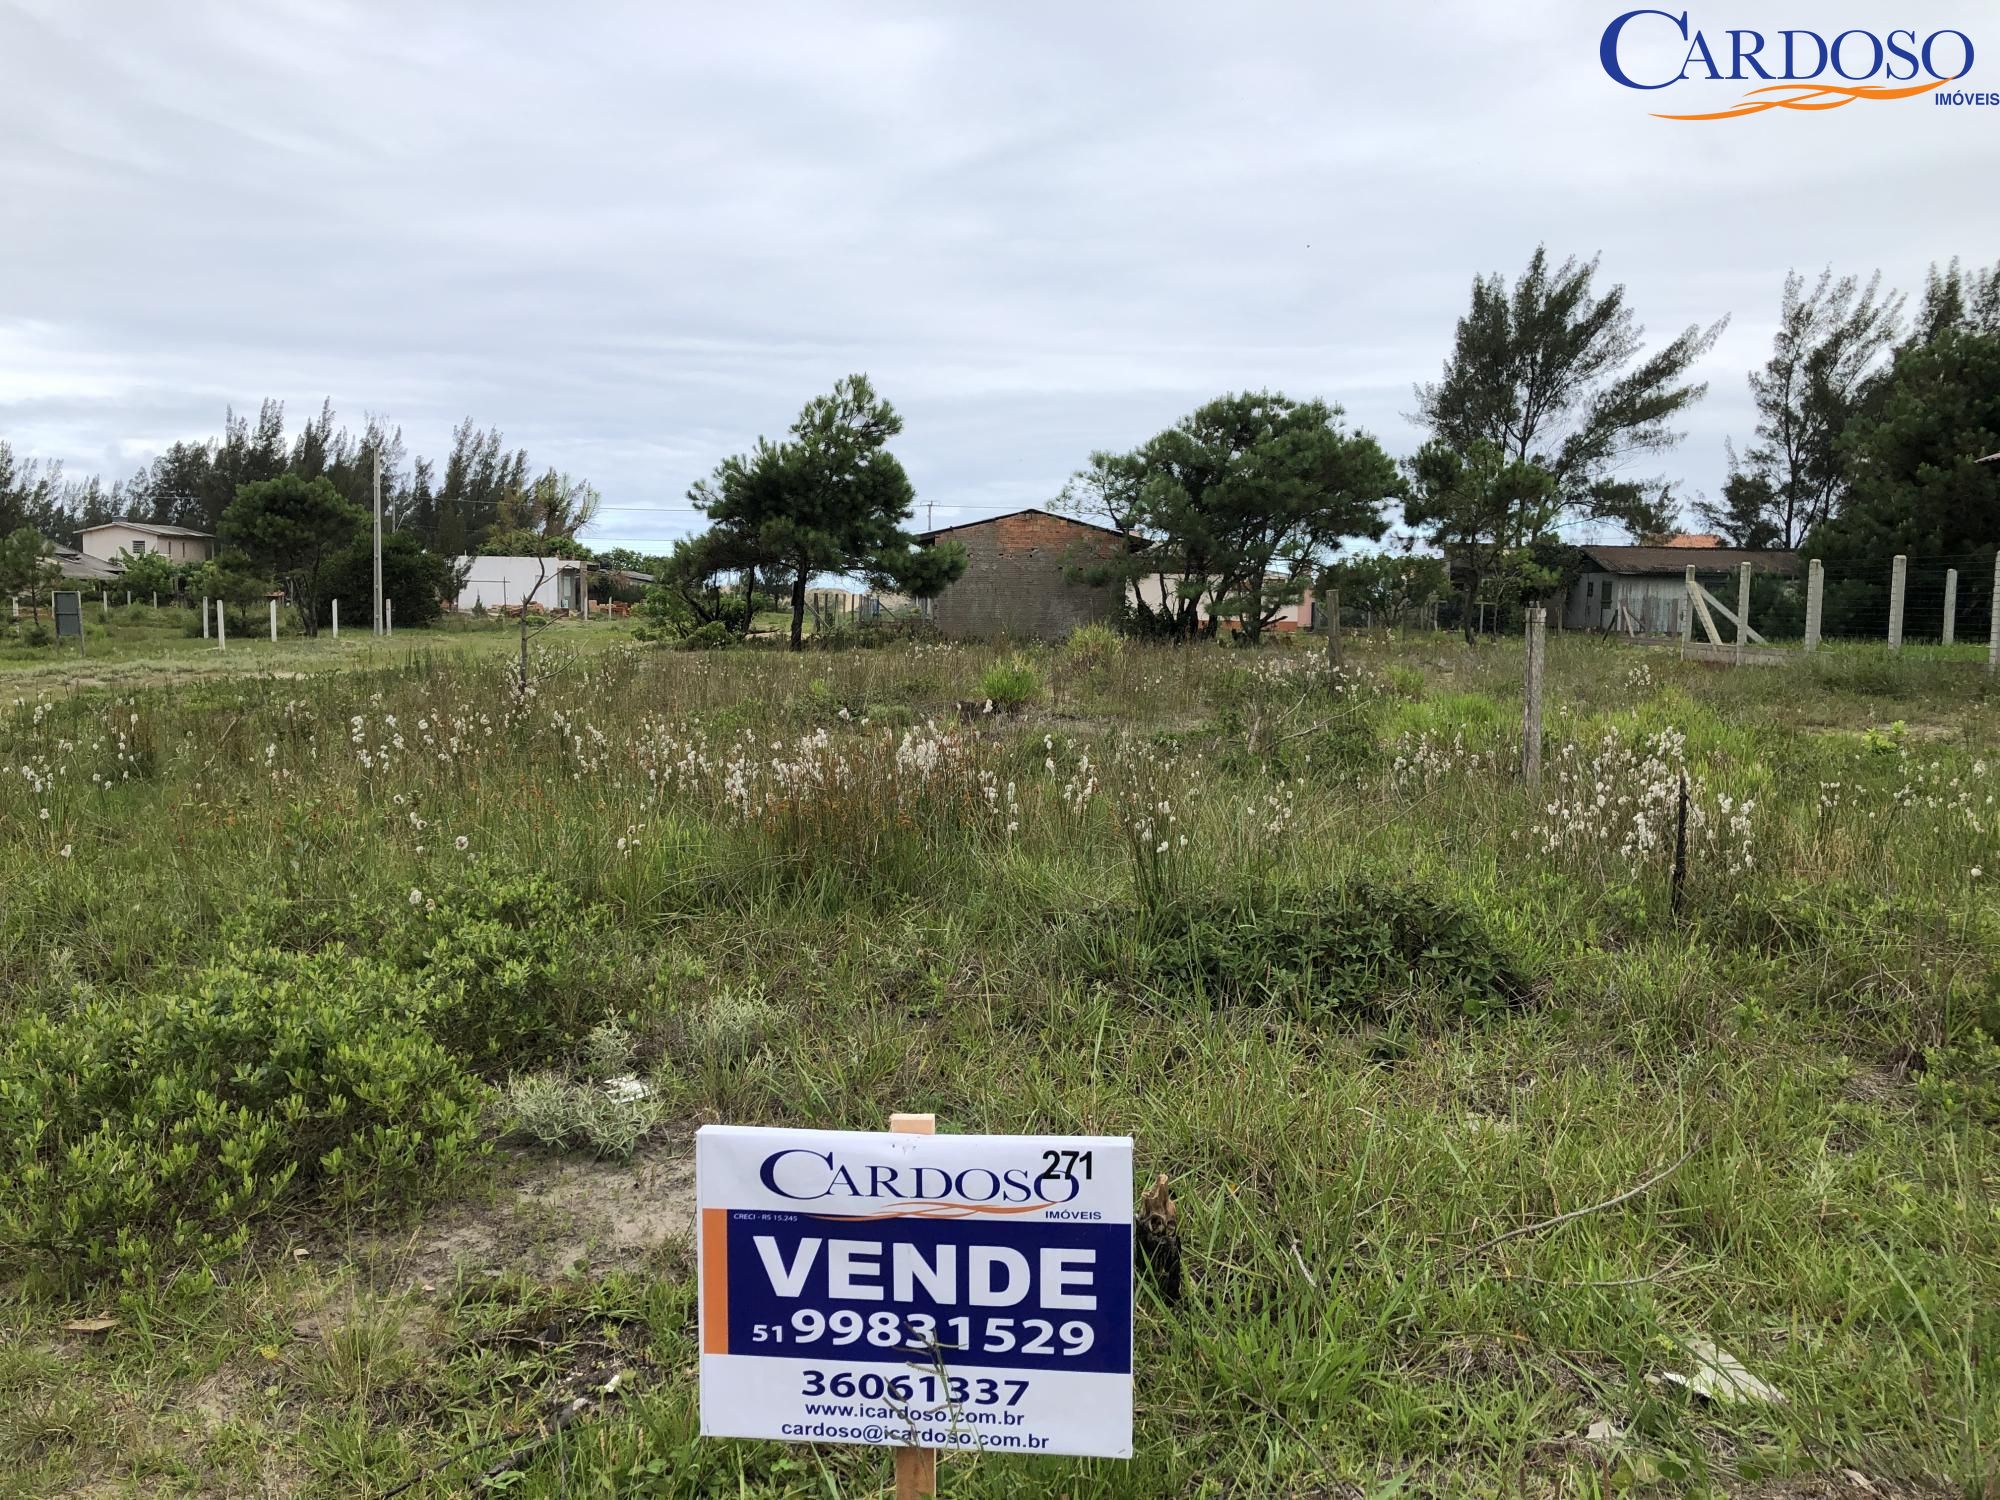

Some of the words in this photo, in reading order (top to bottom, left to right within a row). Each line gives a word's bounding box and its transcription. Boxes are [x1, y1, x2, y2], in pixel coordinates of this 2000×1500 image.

[759, 1149, 1080, 1203] CARDOSO
[1042, 1150, 1094, 1180] 271
[733, 1212, 756, 1221] CRECI
[1044, 1210, 1102, 1221] IMÓVEIS
[752, 1236, 1097, 1311] VENDE
[752, 1324, 783, 1343] 51
[791, 1308, 1095, 1356] 99831529
[801, 1370, 1030, 1406] 36061337
[804, 1401, 1025, 1427] www.icardoso.com.br
[781, 1422, 1050, 1449] cardoso@icardoso.com.br
